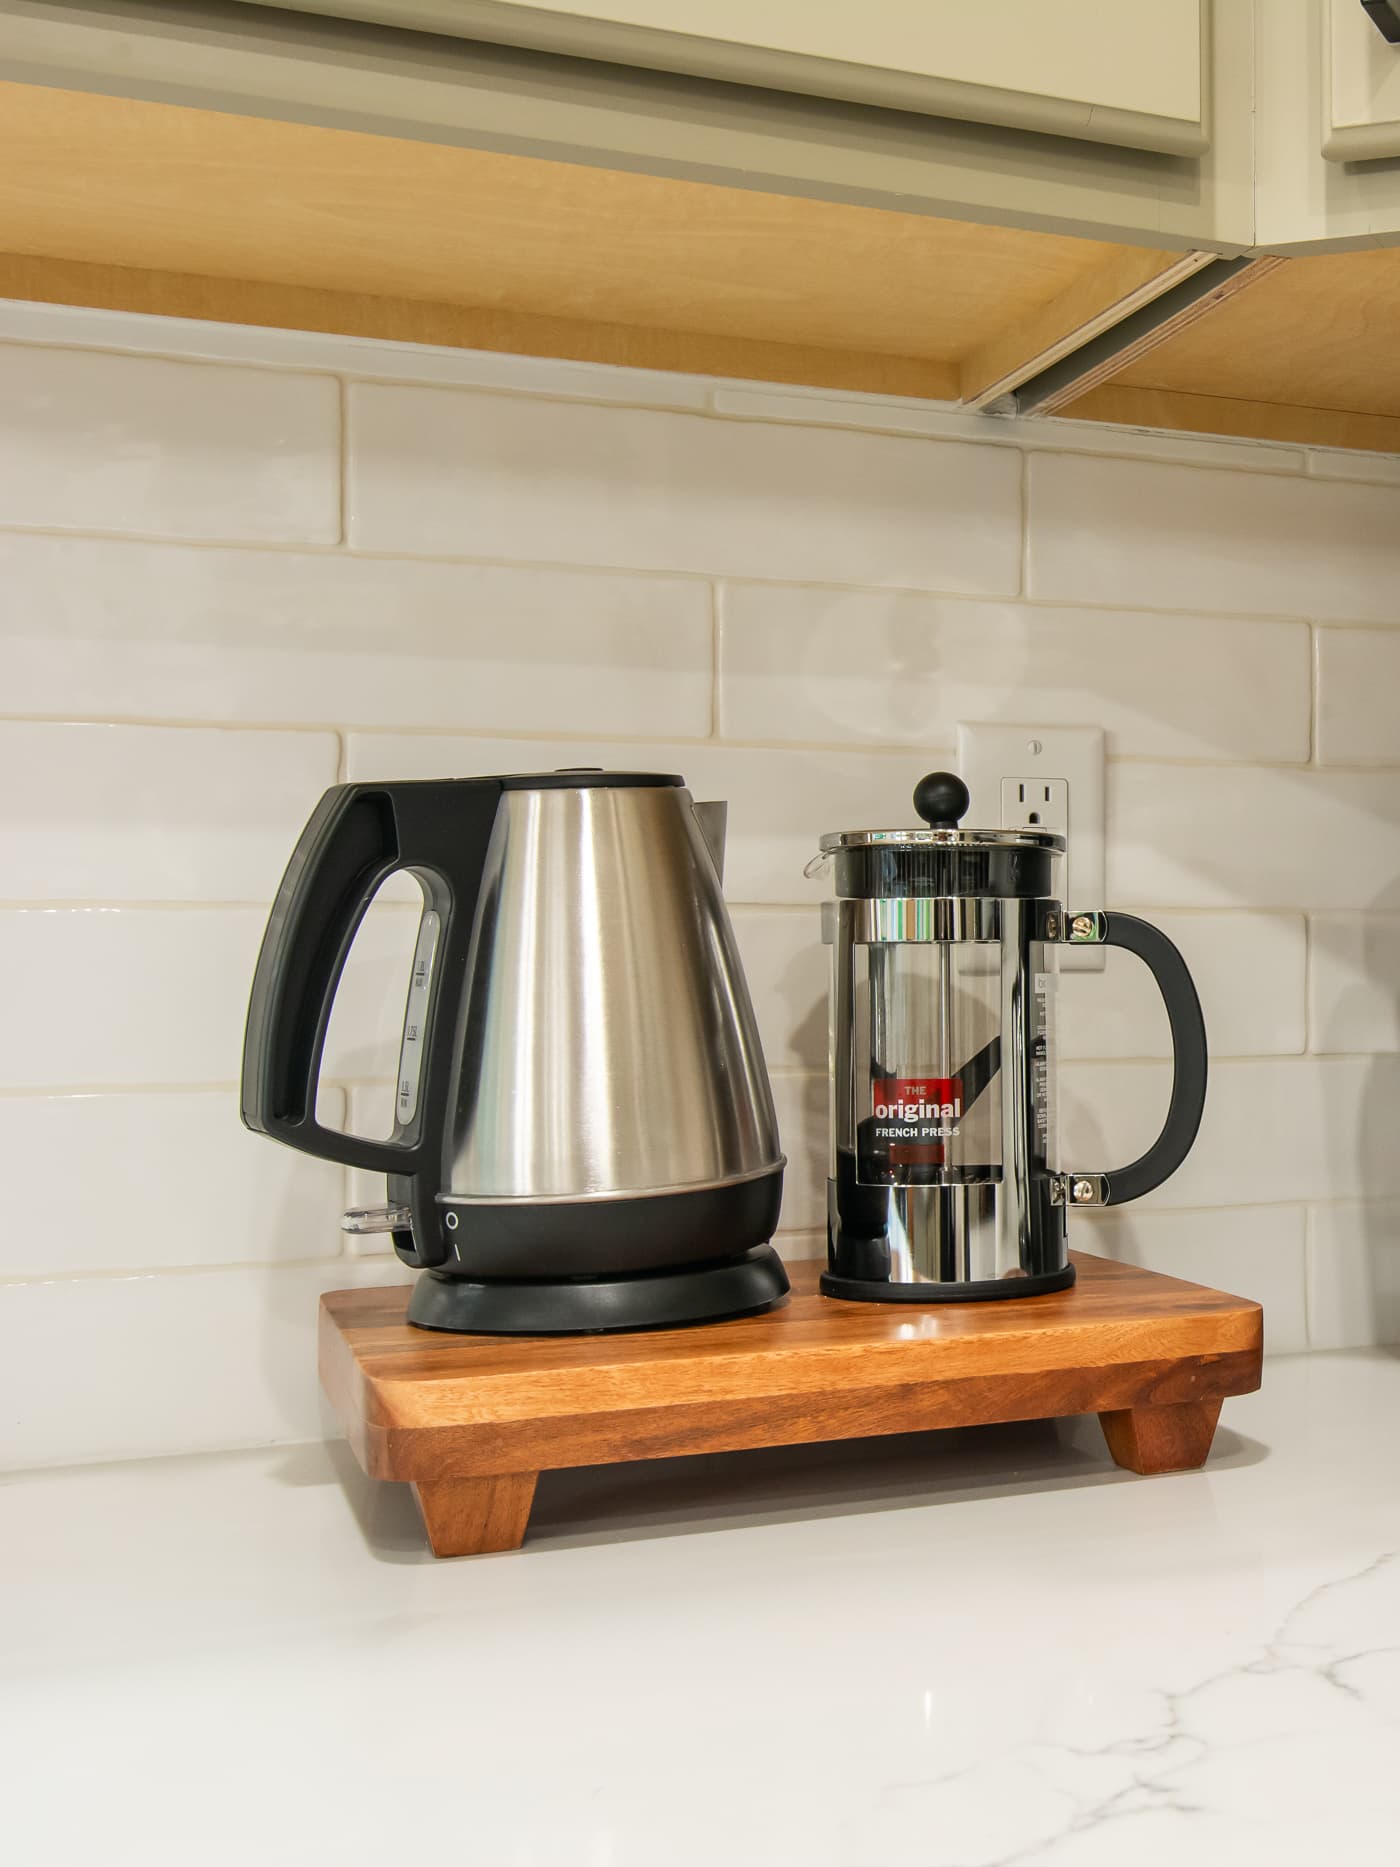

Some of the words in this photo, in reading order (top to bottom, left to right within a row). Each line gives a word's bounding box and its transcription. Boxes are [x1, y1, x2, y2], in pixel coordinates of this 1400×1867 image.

[904, 1085, 927, 1096] THE
[875, 1098, 961, 1123] original
[875, 1127, 918, 1138] FRENCH
[921, 1126, 961, 1137] PRESS
